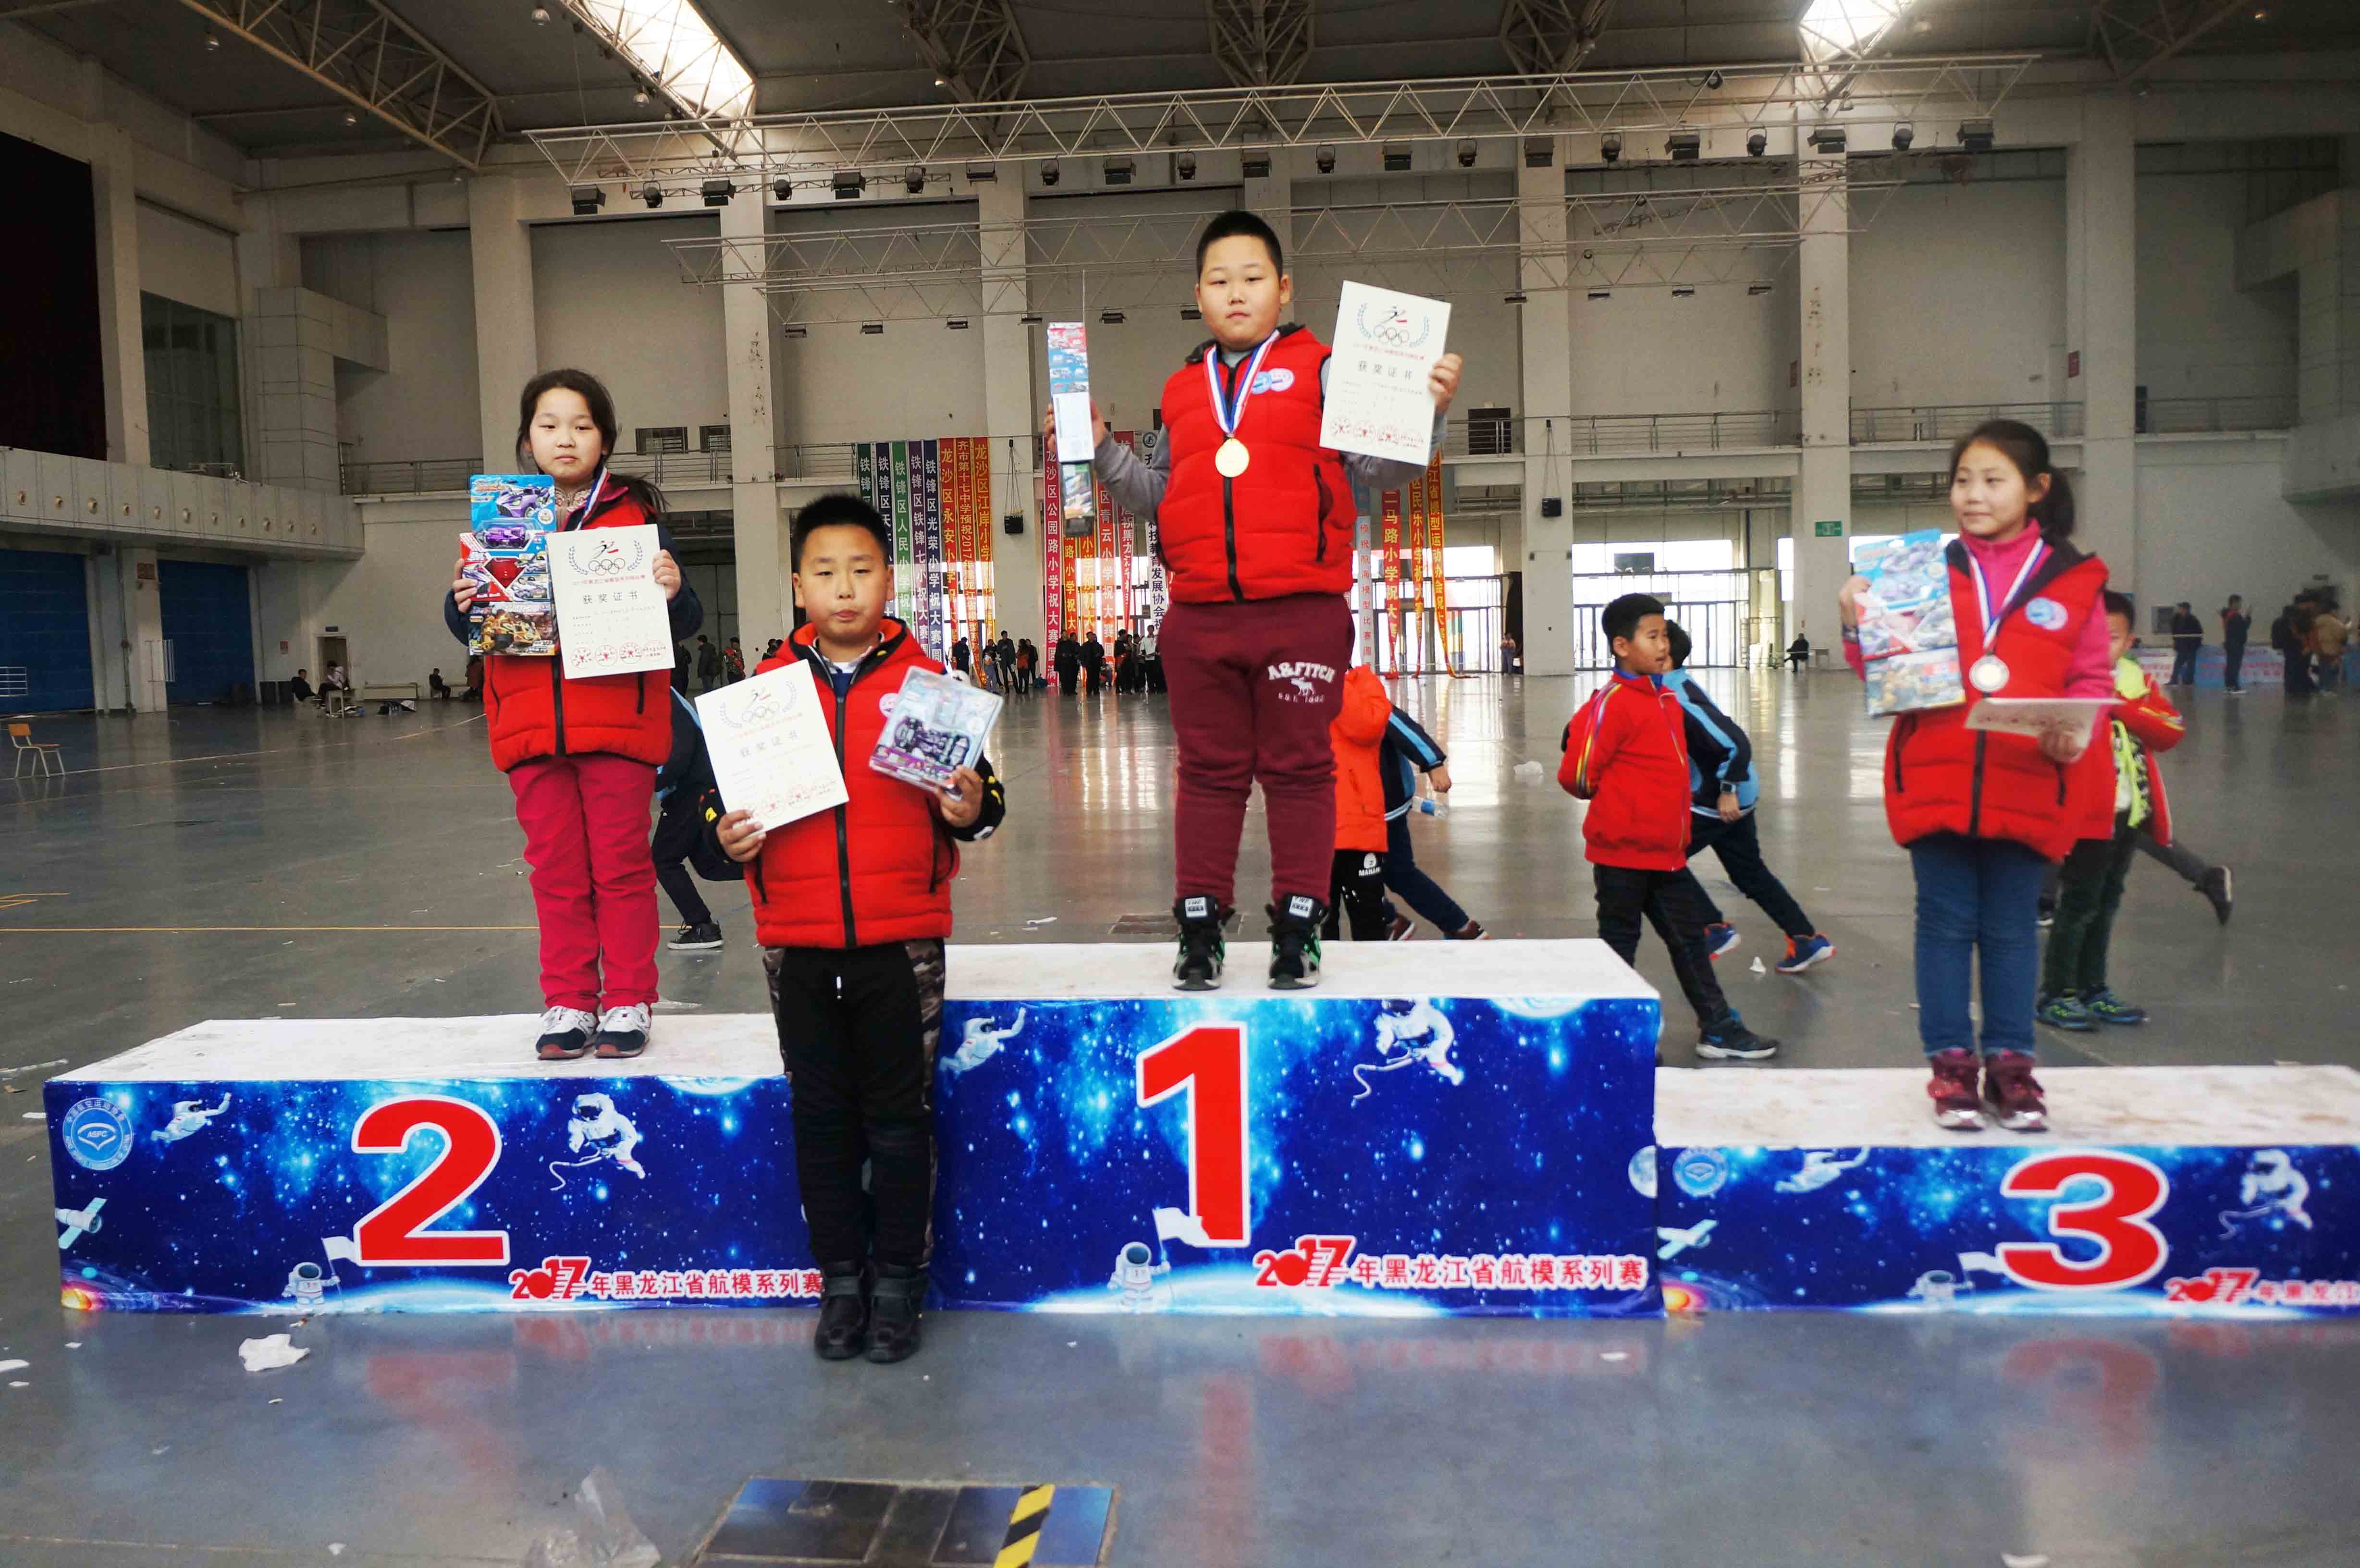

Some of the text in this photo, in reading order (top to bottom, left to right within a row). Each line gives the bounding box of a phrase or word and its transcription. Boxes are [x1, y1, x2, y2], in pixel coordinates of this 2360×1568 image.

[1064, 538, 1077, 629] 路小学祝大
[351, 1094, 509, 1267] 2
[1136, 1022, 1250, 1247] 1
[1996, 1149, 2169, 1291] 3
